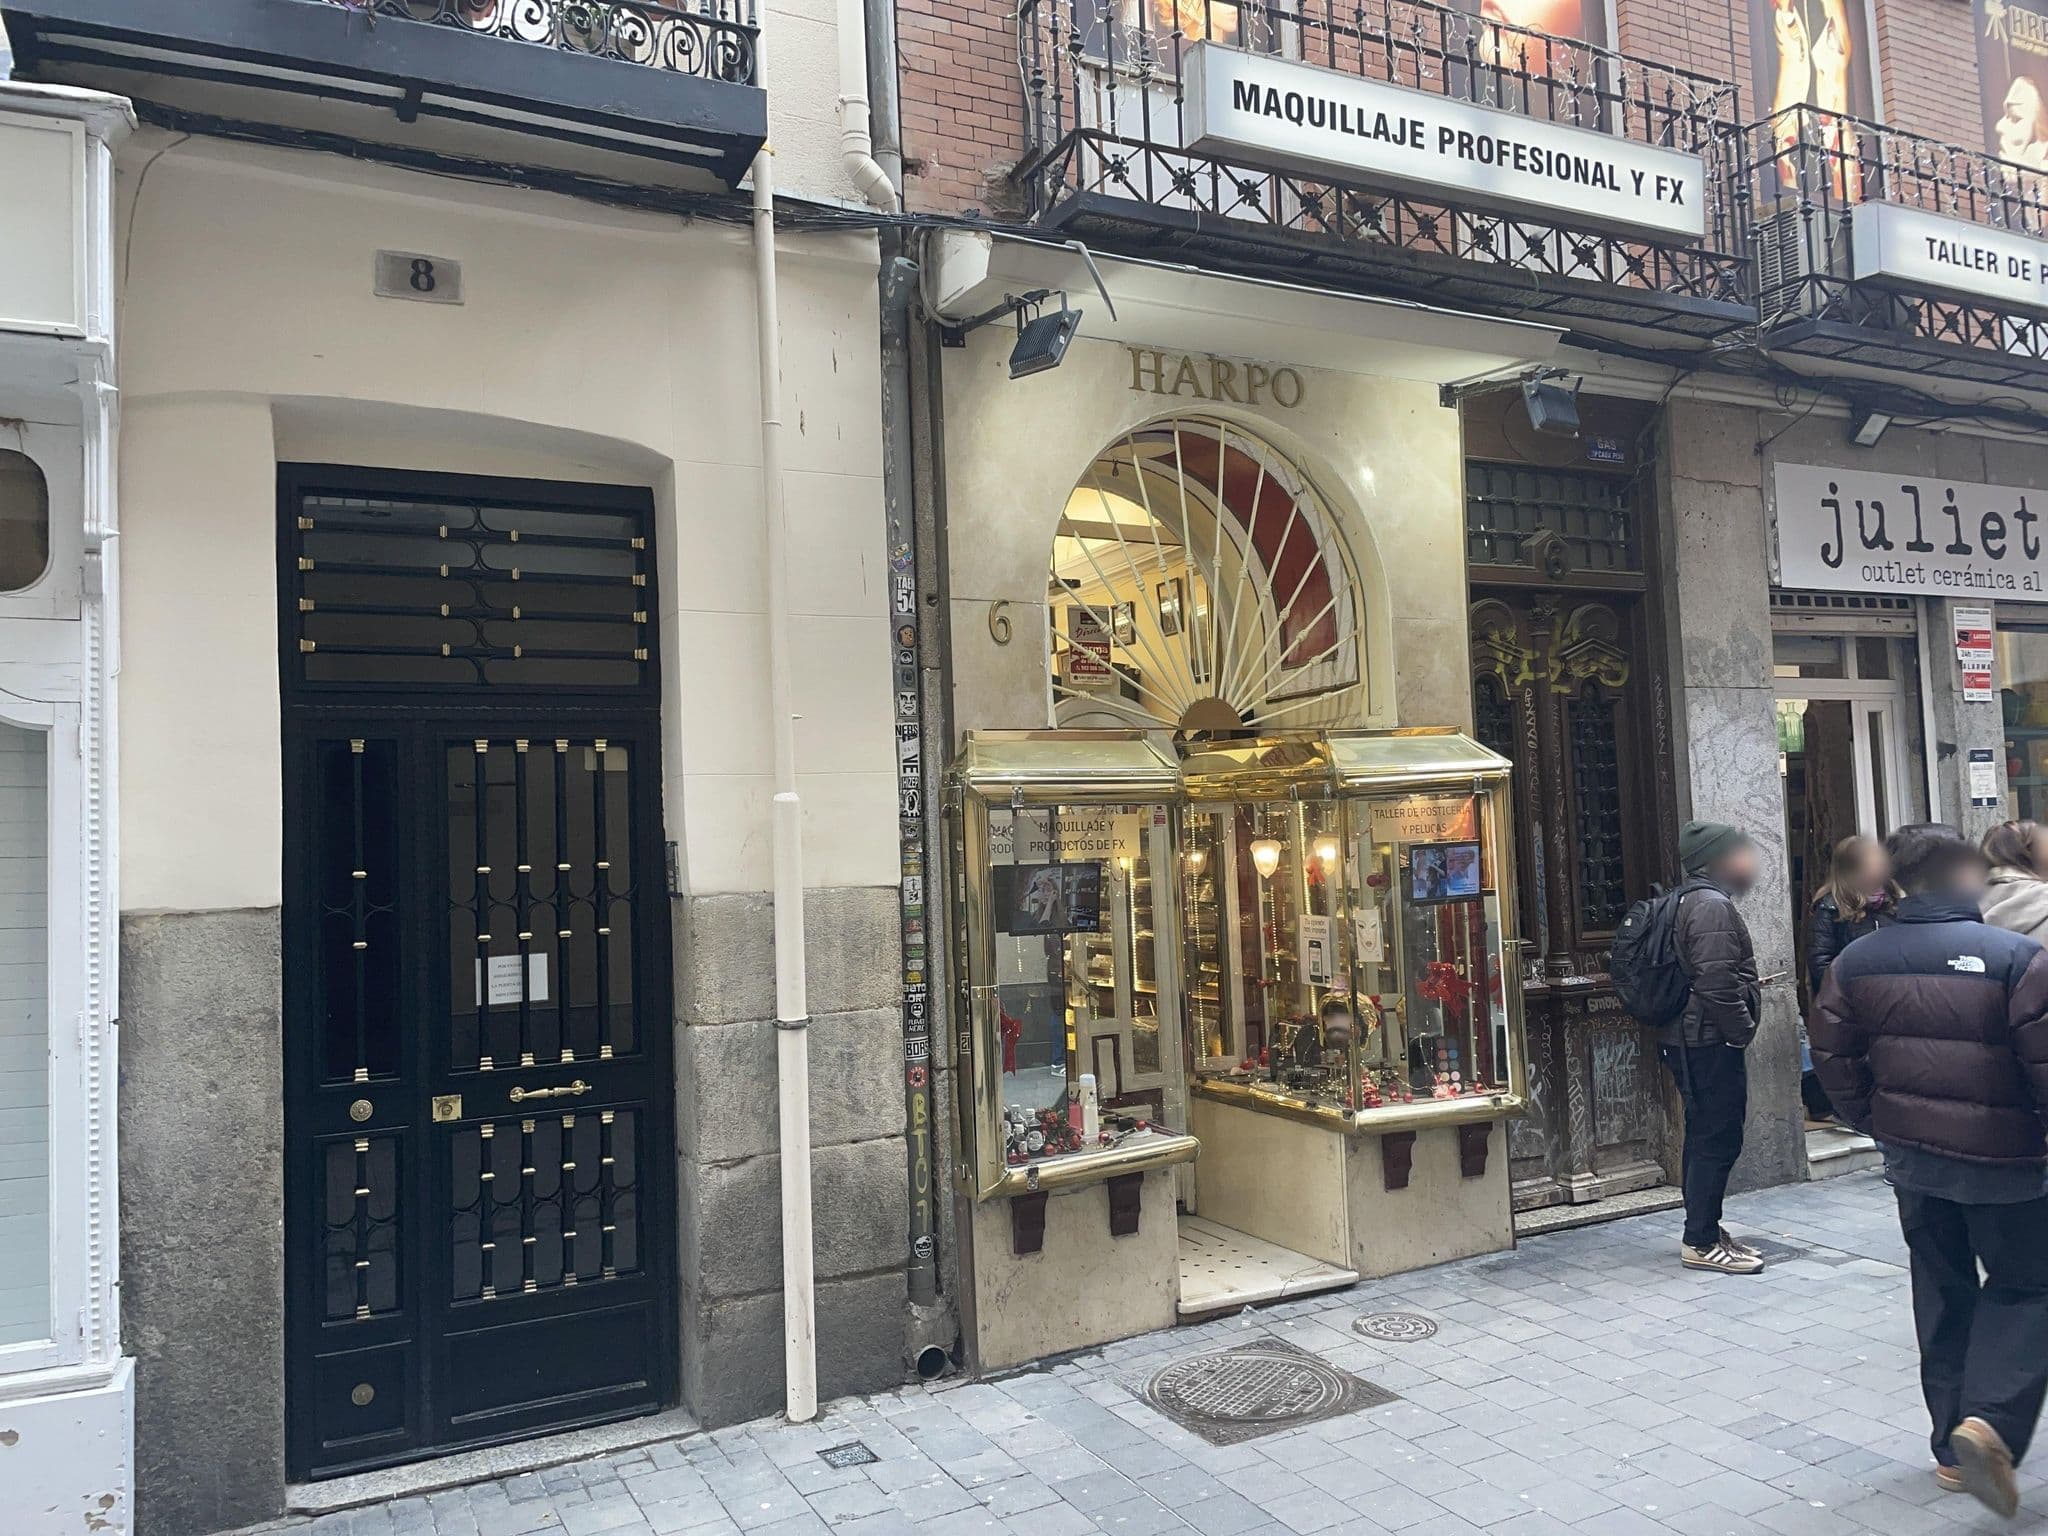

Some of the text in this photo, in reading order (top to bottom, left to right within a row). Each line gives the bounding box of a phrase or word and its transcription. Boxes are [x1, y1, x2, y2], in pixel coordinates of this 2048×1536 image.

[1233, 79, 1685, 206] MAQUILLAJE PROFESIONAL Y FX
[410, 258, 436, 292] 8
[1925, 237, 1999, 274] TALLER
[2008, 256, 2031, 281] DE
[1127, 346, 1305, 408] HARPO
[1820, 481, 2041, 569] juliet
[1861, 560, 2043, 592] outlet cerámica al
[989, 599, 1012, 647] 6
[1039, 819, 1115, 834] MAQUILLAJE Y
[1374, 807, 1405, 819] TALLER
[1407, 807, 1420, 818] DE
[1402, 822, 1447, 836] Y PELUCAS
[1029, 838, 1126, 852] PRODUCTOS DE FX
